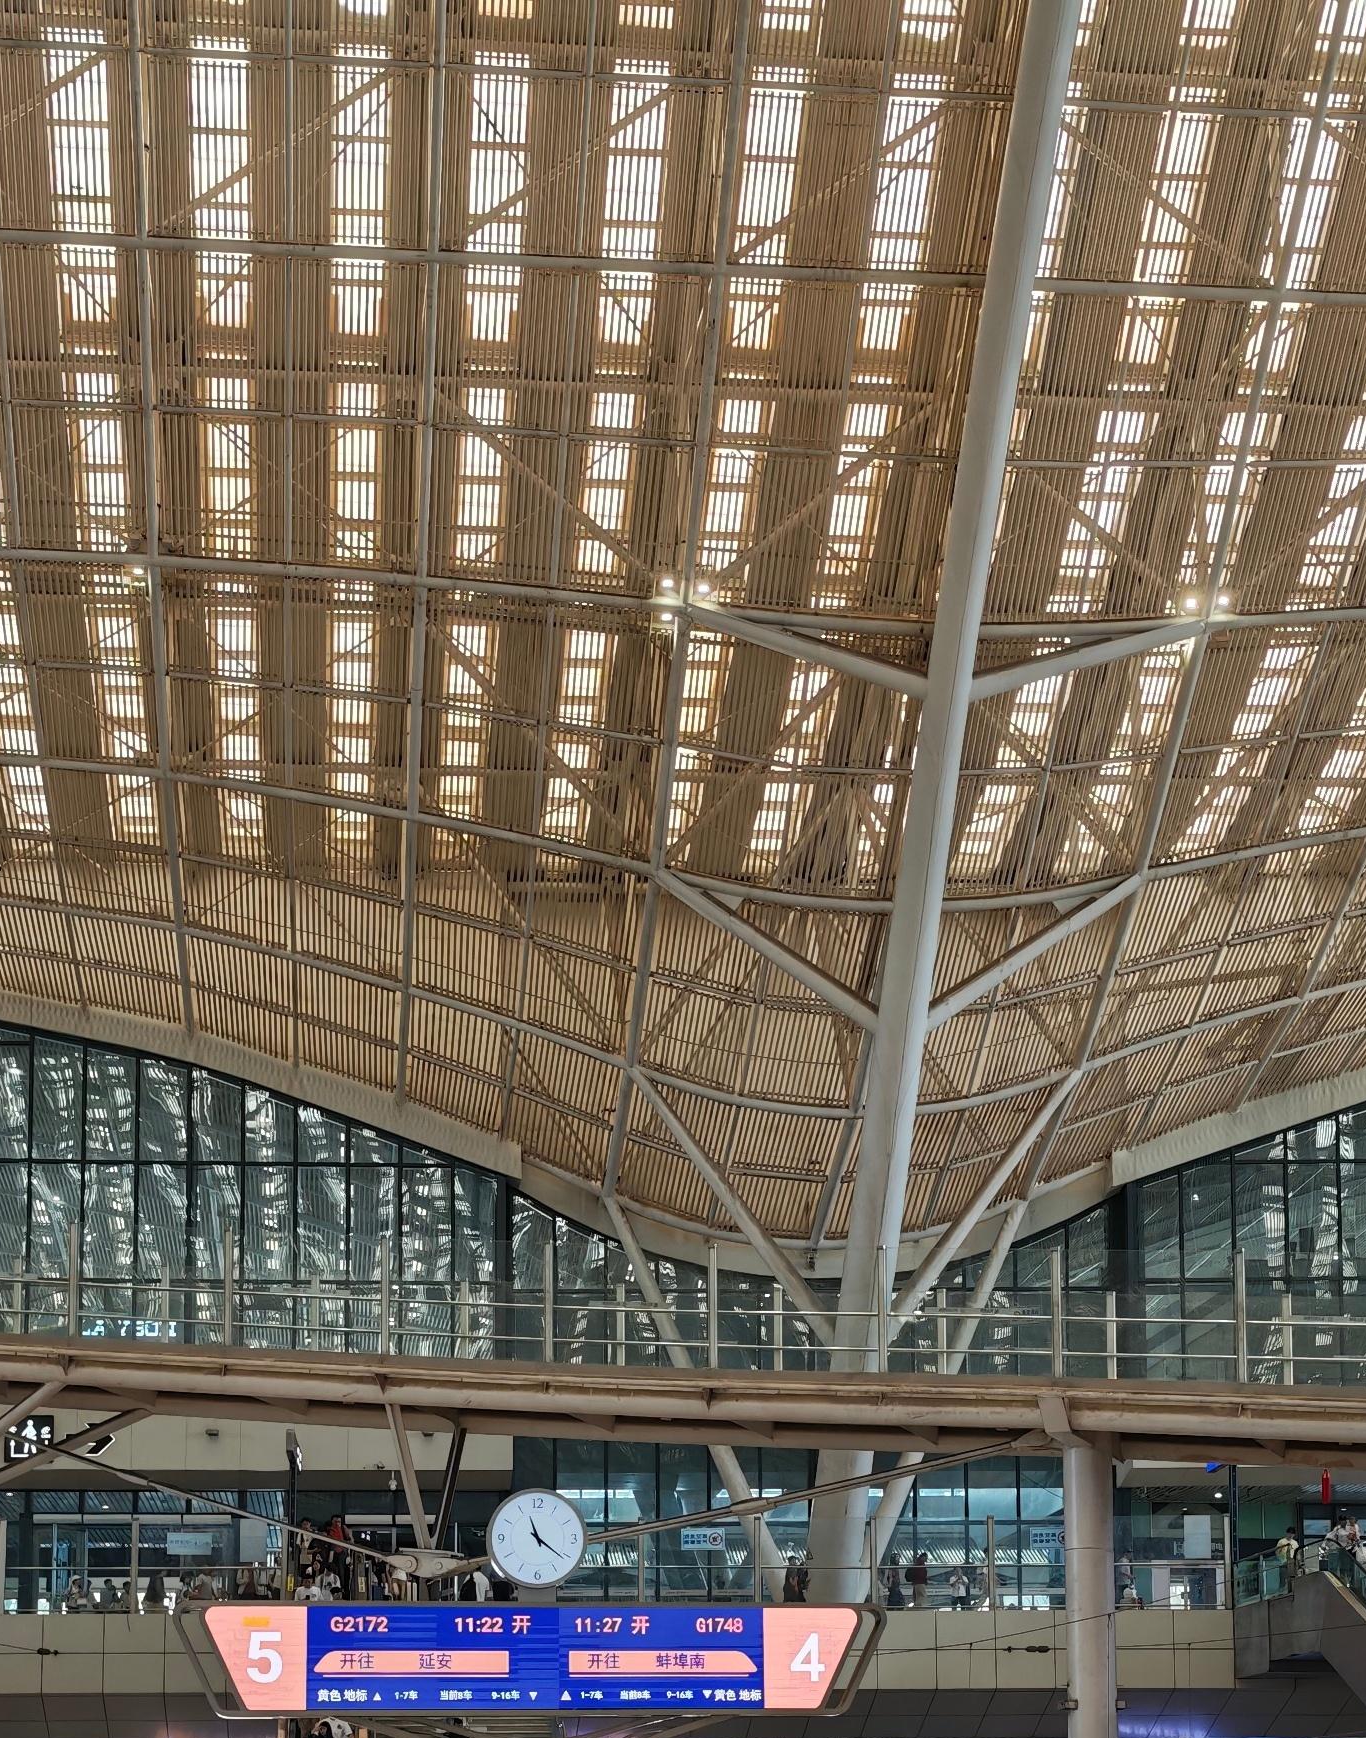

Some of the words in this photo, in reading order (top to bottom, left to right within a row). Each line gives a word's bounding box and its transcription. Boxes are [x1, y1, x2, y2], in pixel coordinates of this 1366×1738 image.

[532, 1498, 544, 1509] 12
[497, 1533, 505, 1544] 9
[571, 1534, 578, 1545] 3
[534, 1570, 542, 1581] 6
[330, 1617, 388, 1633] G2172
[454, 1617, 503, 1633] 11:22
[512, 1615, 531, 1634] 开
[574, 1617, 622, 1633] 11:27
[631, 1615, 650, 1635] 开
[696, 1617, 743, 1633] G1748
[246, 1631, 283, 1684] 5
[340, 1652, 375, 1670] 开往
[419, 1652, 452, 1670] 延安
[587, 1653, 620, 1670] 开往
[655, 1653, 706, 1670] 蚌埠南
[789, 1632, 826, 1682] 4
[317, 1689, 341, 1702] 黄色
[714, 1689, 737, 1702] 黄色
[739, 1689, 762, 1702] 地标
